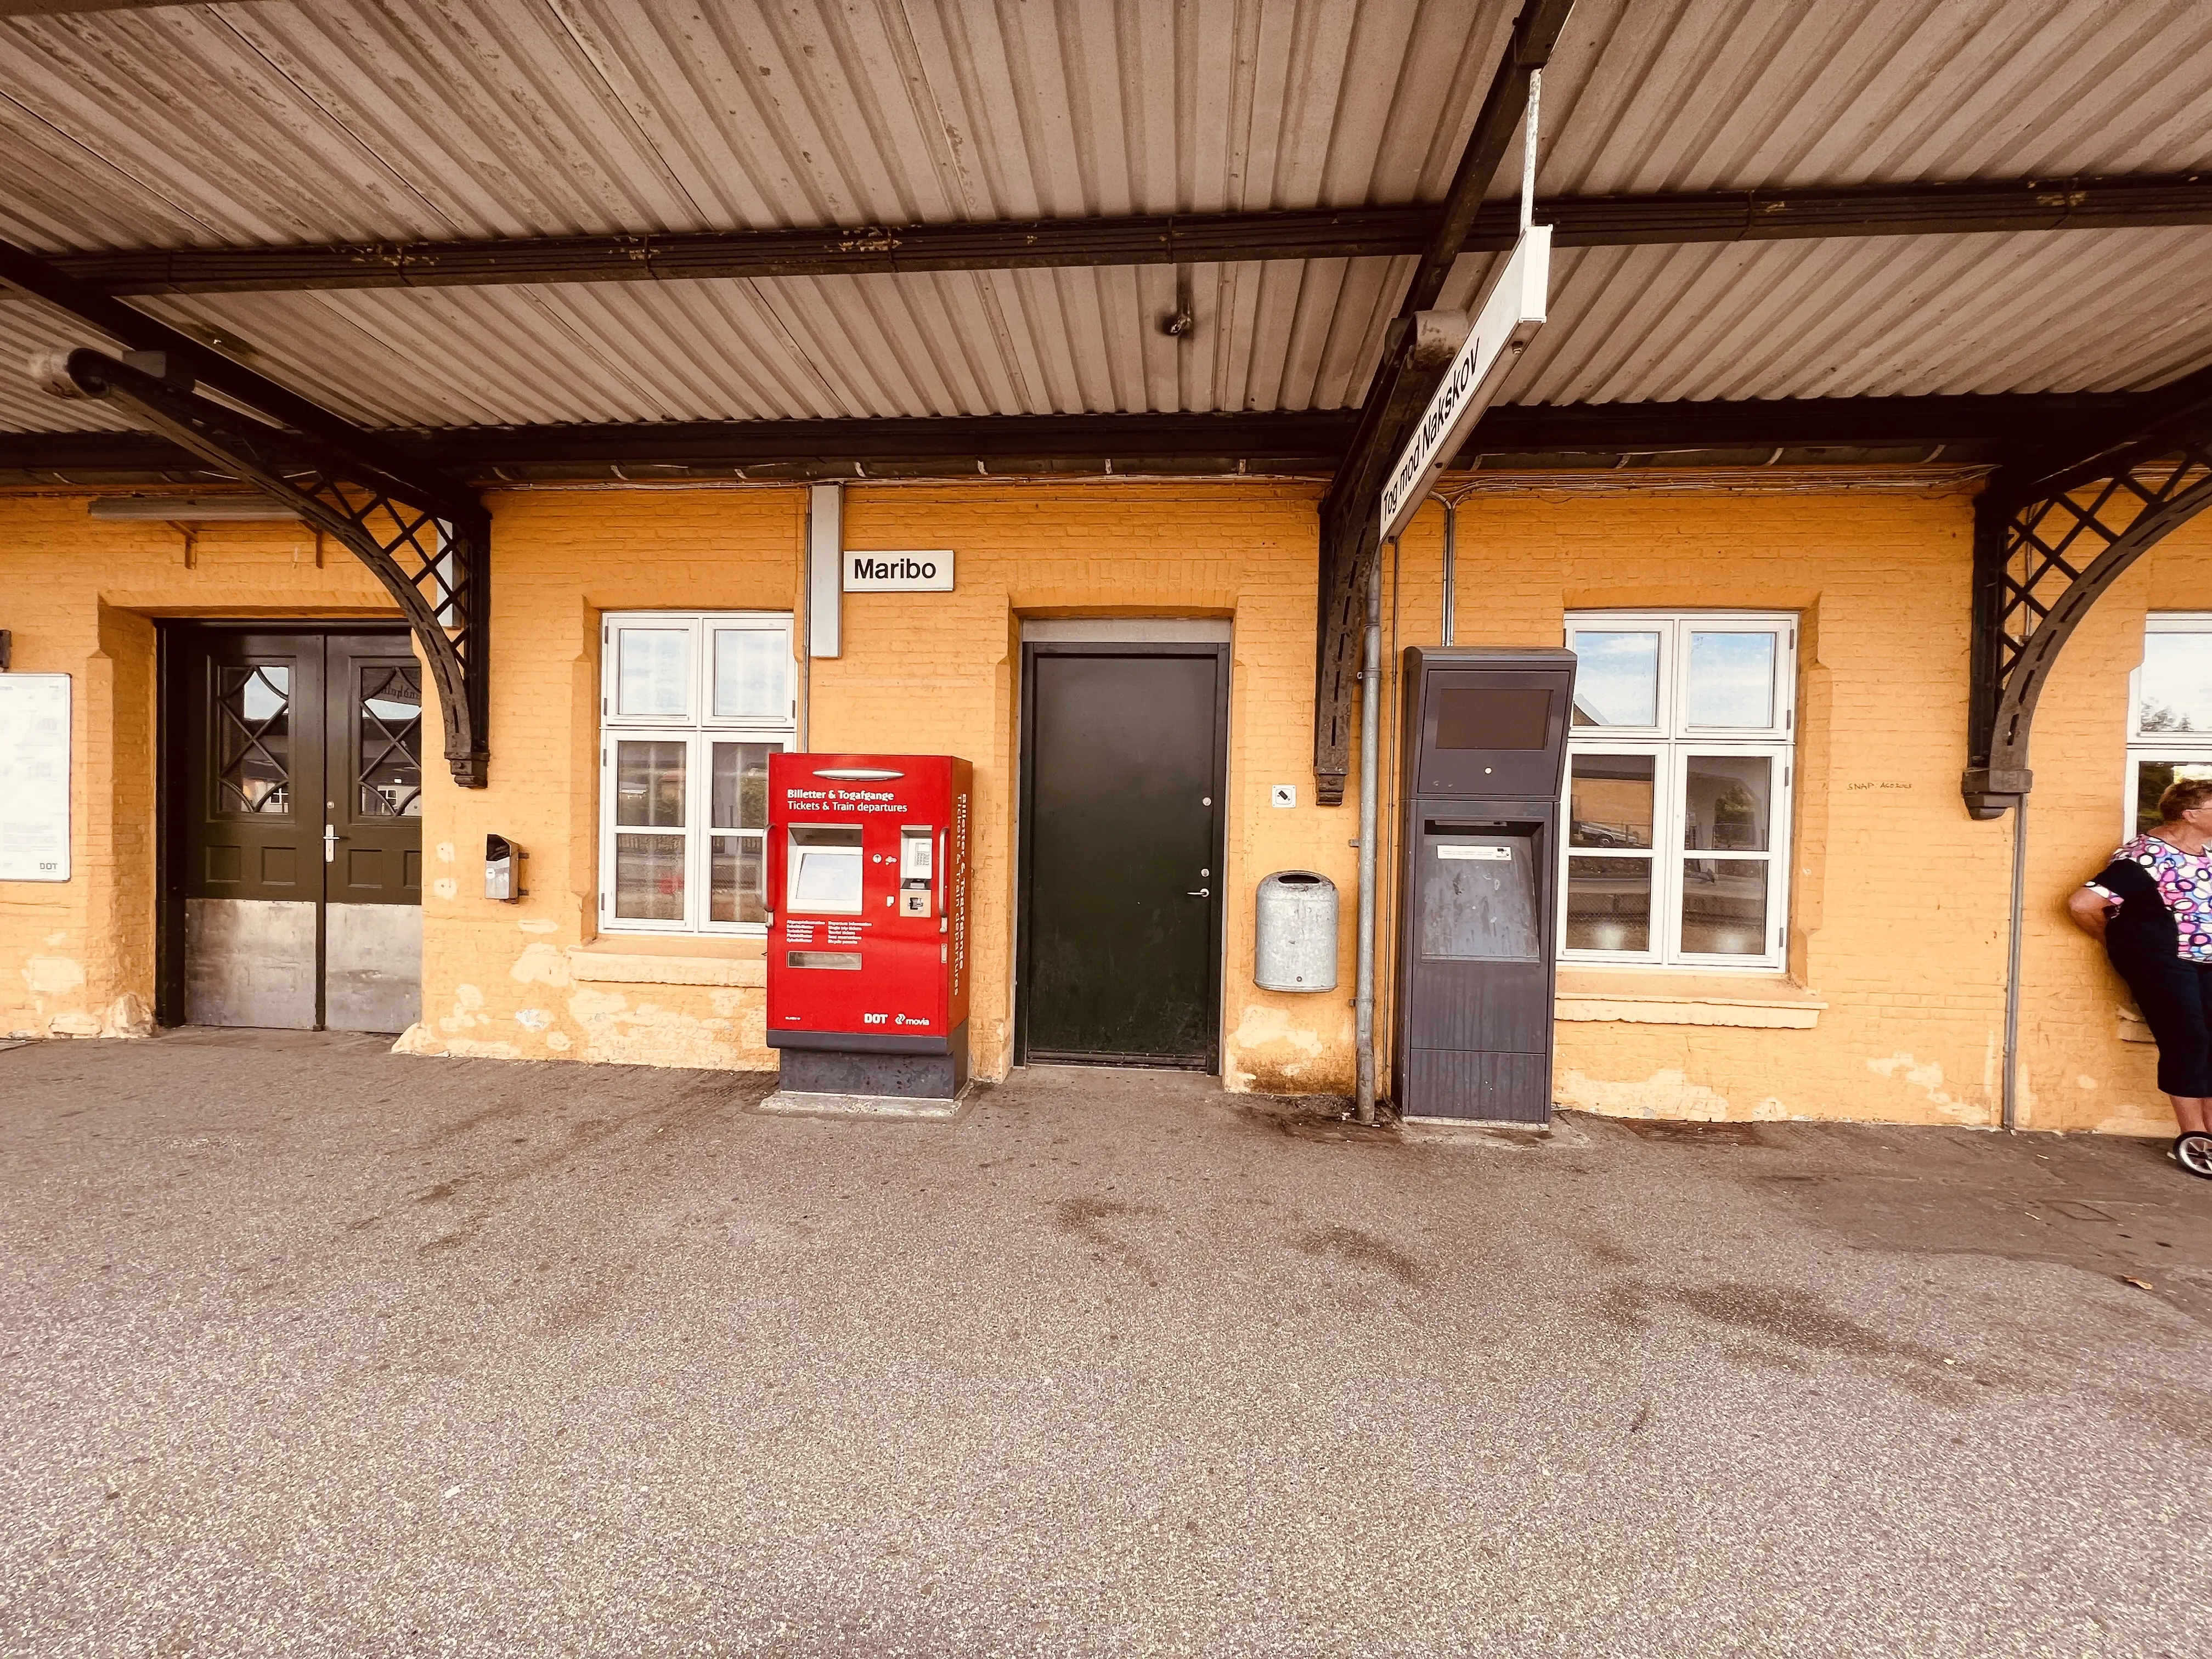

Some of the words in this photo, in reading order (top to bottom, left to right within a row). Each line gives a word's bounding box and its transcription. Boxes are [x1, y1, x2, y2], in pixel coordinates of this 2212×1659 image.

[1384, 480, 1398, 522] Tog
[1399, 435, 1420, 497] mod
[1422, 336, 1480, 460] Nakskov
[854, 558, 936, 579] Maribo
[787, 789, 826, 799] Billetter
[828, 789, 836, 799] &
[838, 790, 894, 802] Togafgange
[787, 801, 820, 810] Tickets
[822, 802, 830, 811] &
[832, 802, 855, 811] Train
[857, 802, 907, 813] departures
[864, 1013, 888, 1024] DOT
